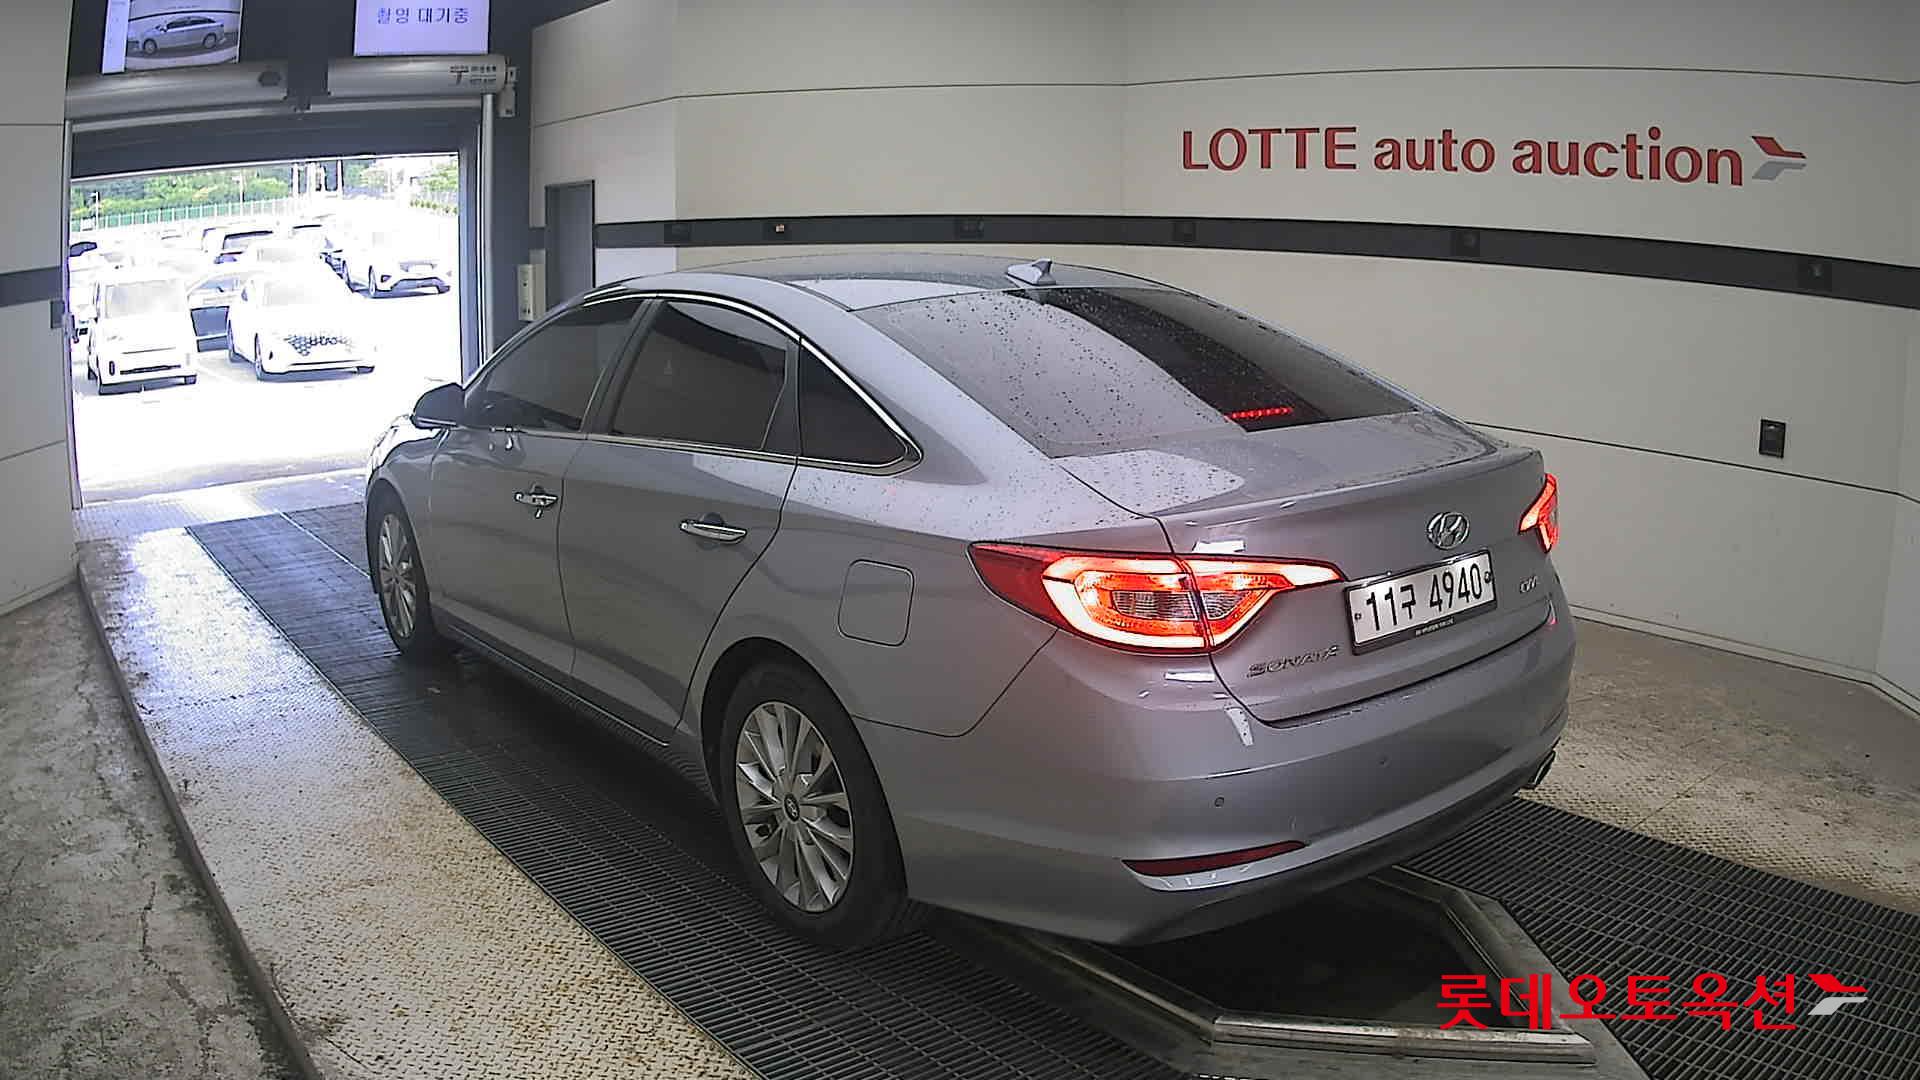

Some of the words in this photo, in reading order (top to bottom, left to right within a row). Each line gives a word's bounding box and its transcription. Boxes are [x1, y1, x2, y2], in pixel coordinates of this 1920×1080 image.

[418, 7, 470, 24] 대기중
[1182, 126, 1358, 172] LOTTE
[1373, 128, 1496, 173] auto
[1511, 126, 1744, 187] auction
[1365, 584, 1417, 631] 11구
[1429, 563, 1483, 612] 4940
